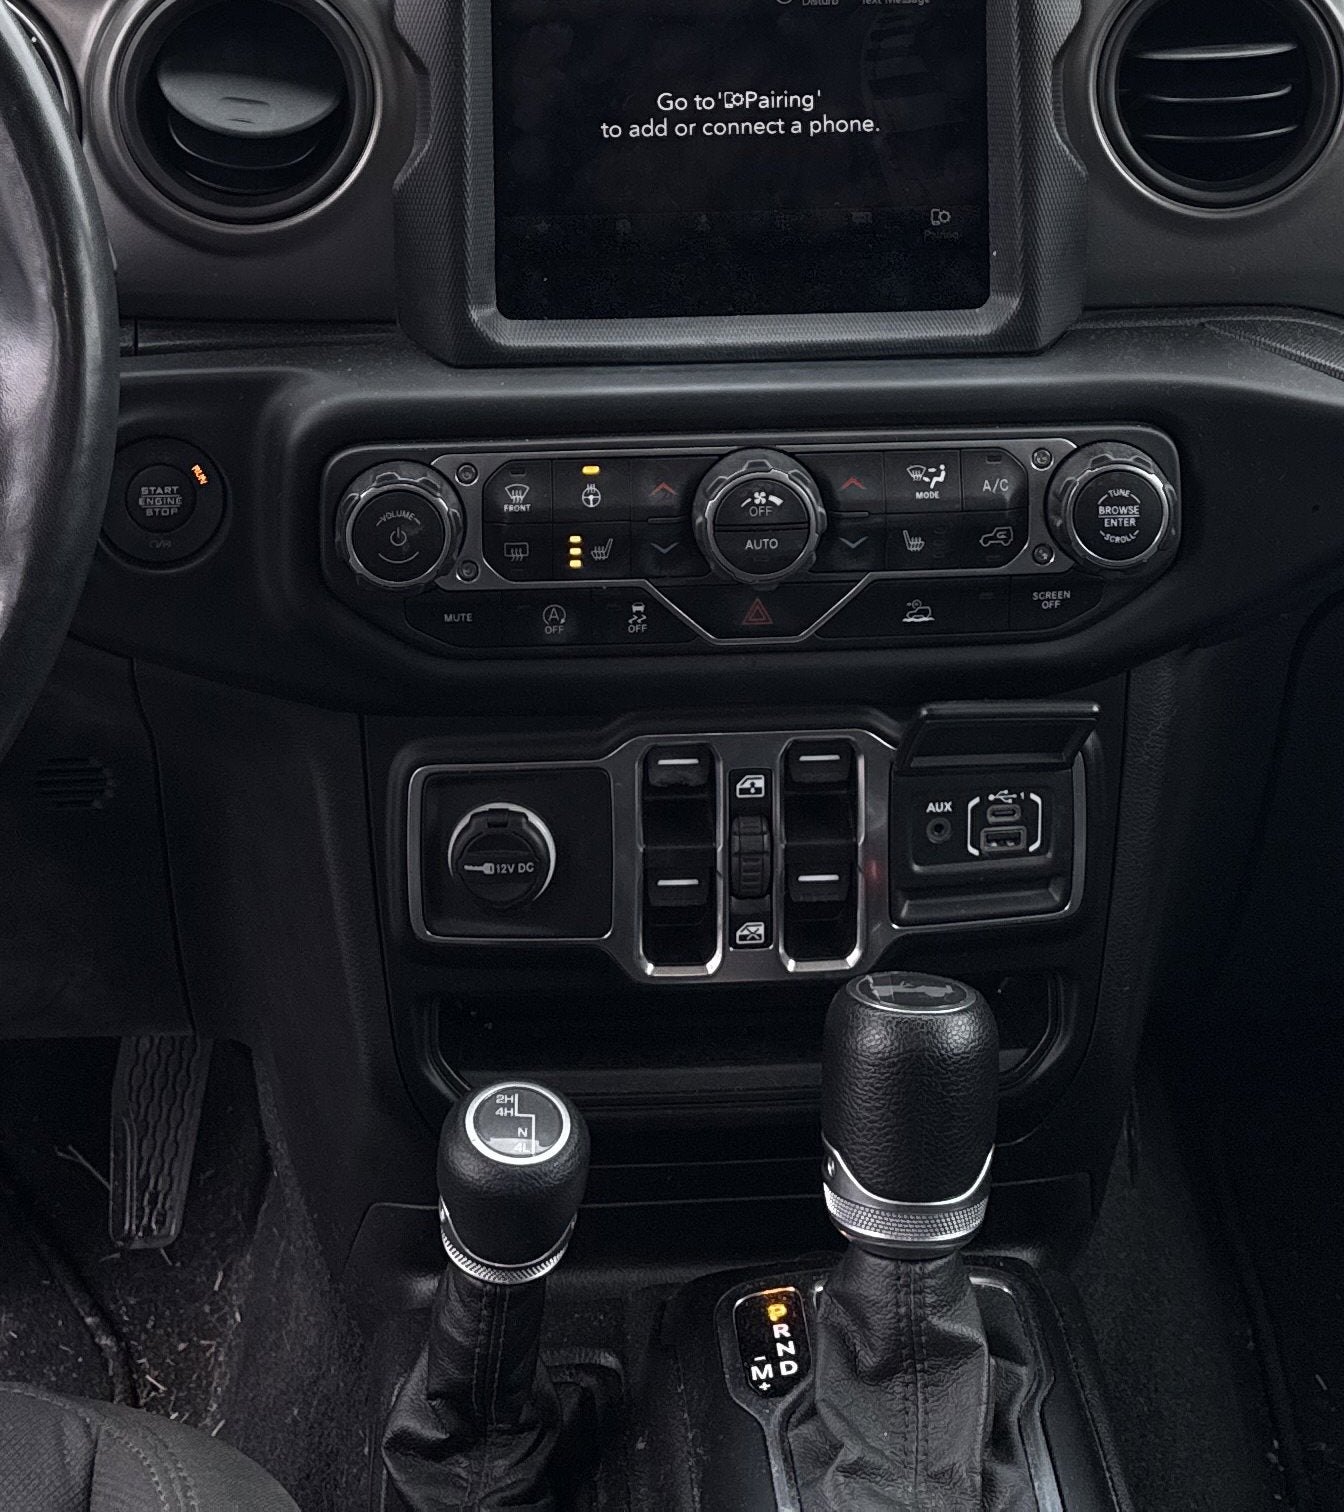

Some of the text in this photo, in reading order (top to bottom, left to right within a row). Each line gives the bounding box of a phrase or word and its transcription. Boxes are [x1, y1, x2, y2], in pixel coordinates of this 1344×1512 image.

[656, 92, 689, 113] Go
[693, 93, 716, 111] to
[601, 115, 881, 139] to add or connect a phone.
[141, 486, 180, 495] START
[981, 478, 1009, 493] A/C
[915, 491, 940, 500] MODE
[1107, 488, 1131, 500] TUNE
[138, 496, 183, 506] ENGINE
[146, 508, 178, 517] STOP
[503, 503, 532, 513] FRONT
[749, 505, 773, 517] OFF
[1097, 504, 1140, 516] BROWSE
[380, 508, 417, 522] VOLUME
[1103, 518, 1136, 528] ENTER
[1103, 530, 1137, 545] SCROLL
[744, 538, 778, 550] AUTO
[1032, 590, 1071, 600] SCREEN
[1041, 599, 1061, 609] OFF
[443, 612, 473, 623] MUTE
[545, 624, 564, 634] OFF
[627, 623, 648, 633] OFF
[925, 801, 953, 813] AUX
[496, 862, 535, 874] 12V DC
[495, 1094, 514, 1104] 2H
[495, 1107, 514, 1118] 4H
[517, 1127, 529, 1138] N
[772, 1323, 792, 1339] R
[776, 1341, 796, 1357] N
[750, 1363, 774, 1381] M
[779, 1360, 799, 1376] D
